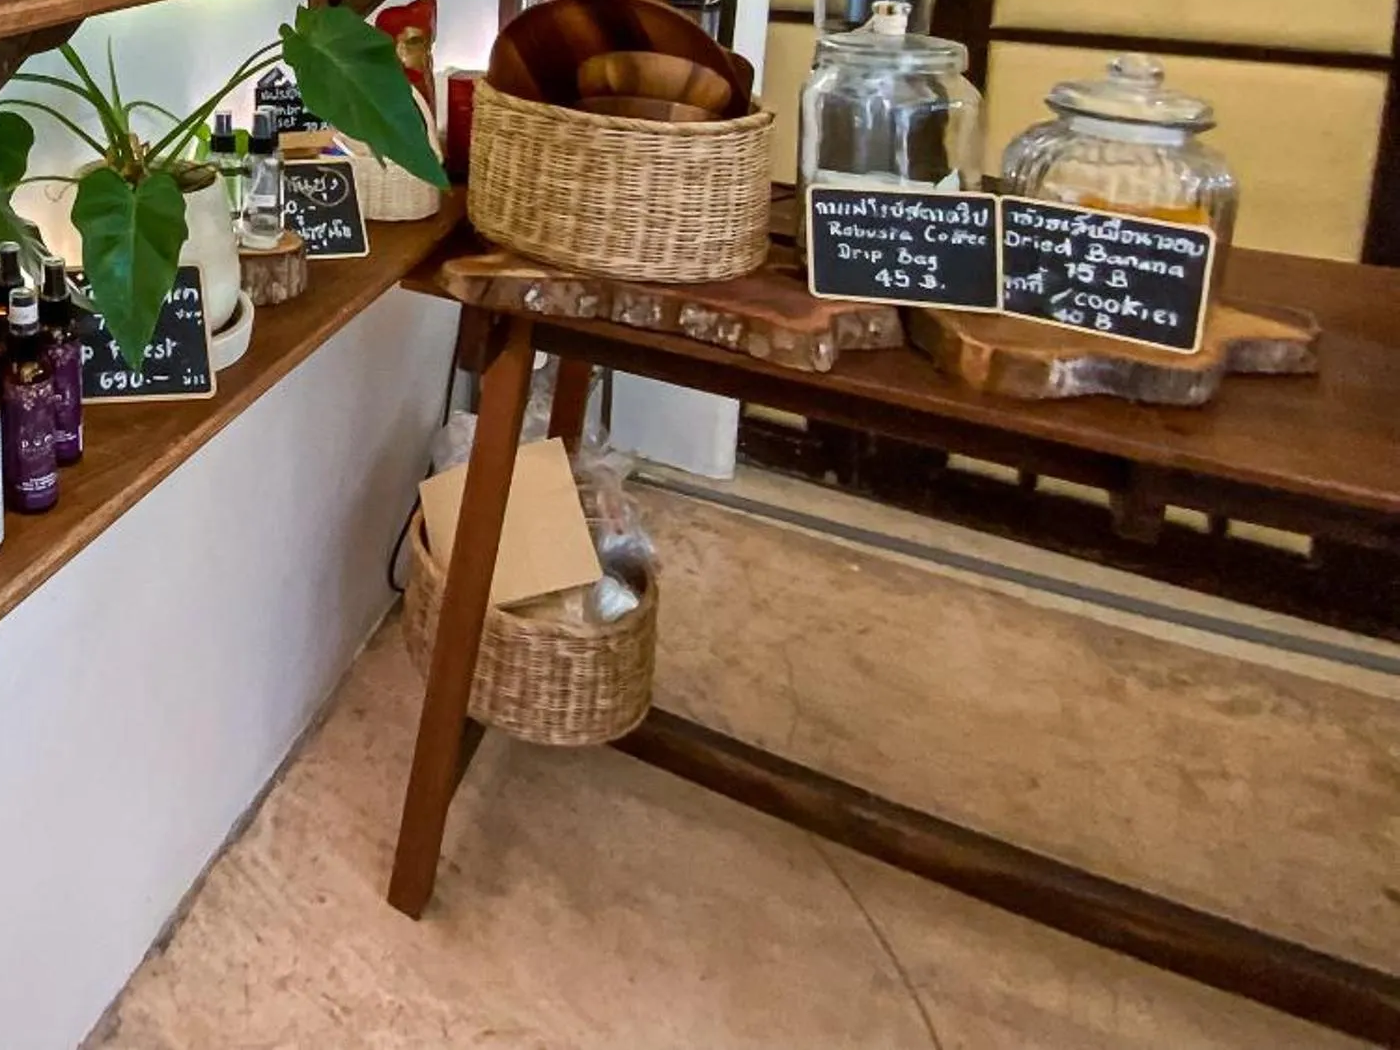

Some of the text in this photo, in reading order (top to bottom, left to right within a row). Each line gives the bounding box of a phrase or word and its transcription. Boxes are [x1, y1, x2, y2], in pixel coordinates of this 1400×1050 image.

[827, 220, 988, 246] Robusta Coffee
[837, 242, 883, 263] Drip
[1003, 229, 1185, 279] Dried Banana
[874, 267, 911, 289] 45
